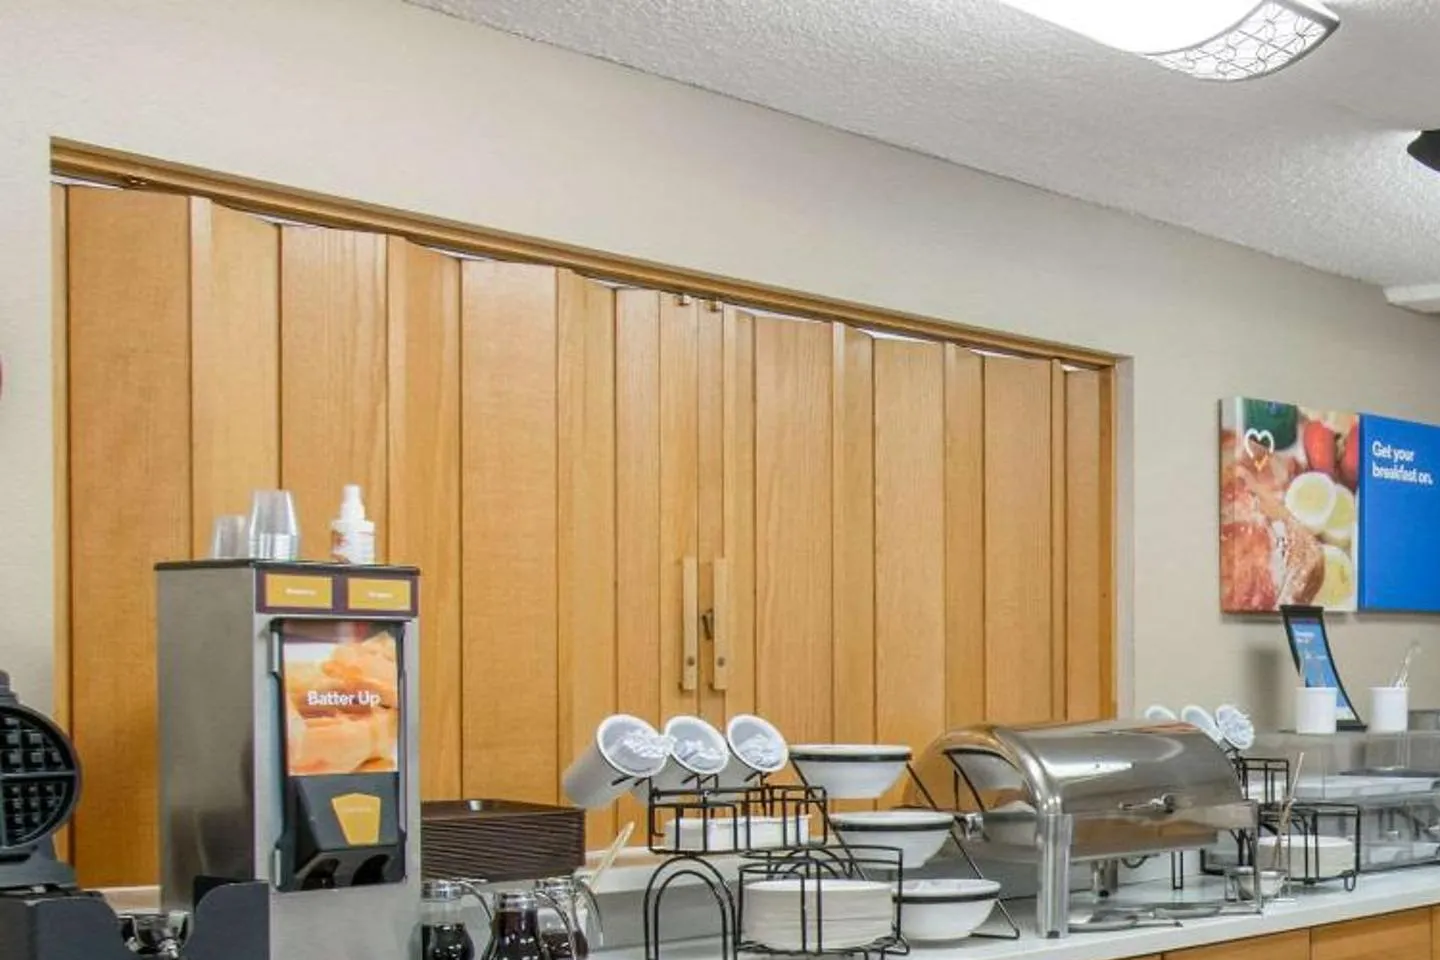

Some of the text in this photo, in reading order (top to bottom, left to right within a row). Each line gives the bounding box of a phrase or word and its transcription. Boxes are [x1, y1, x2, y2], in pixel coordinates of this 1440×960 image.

[1371, 440, 1415, 463] Get your
[1371, 461, 1434, 486] breakfast on.
[307, 689, 382, 708] Batter Up
